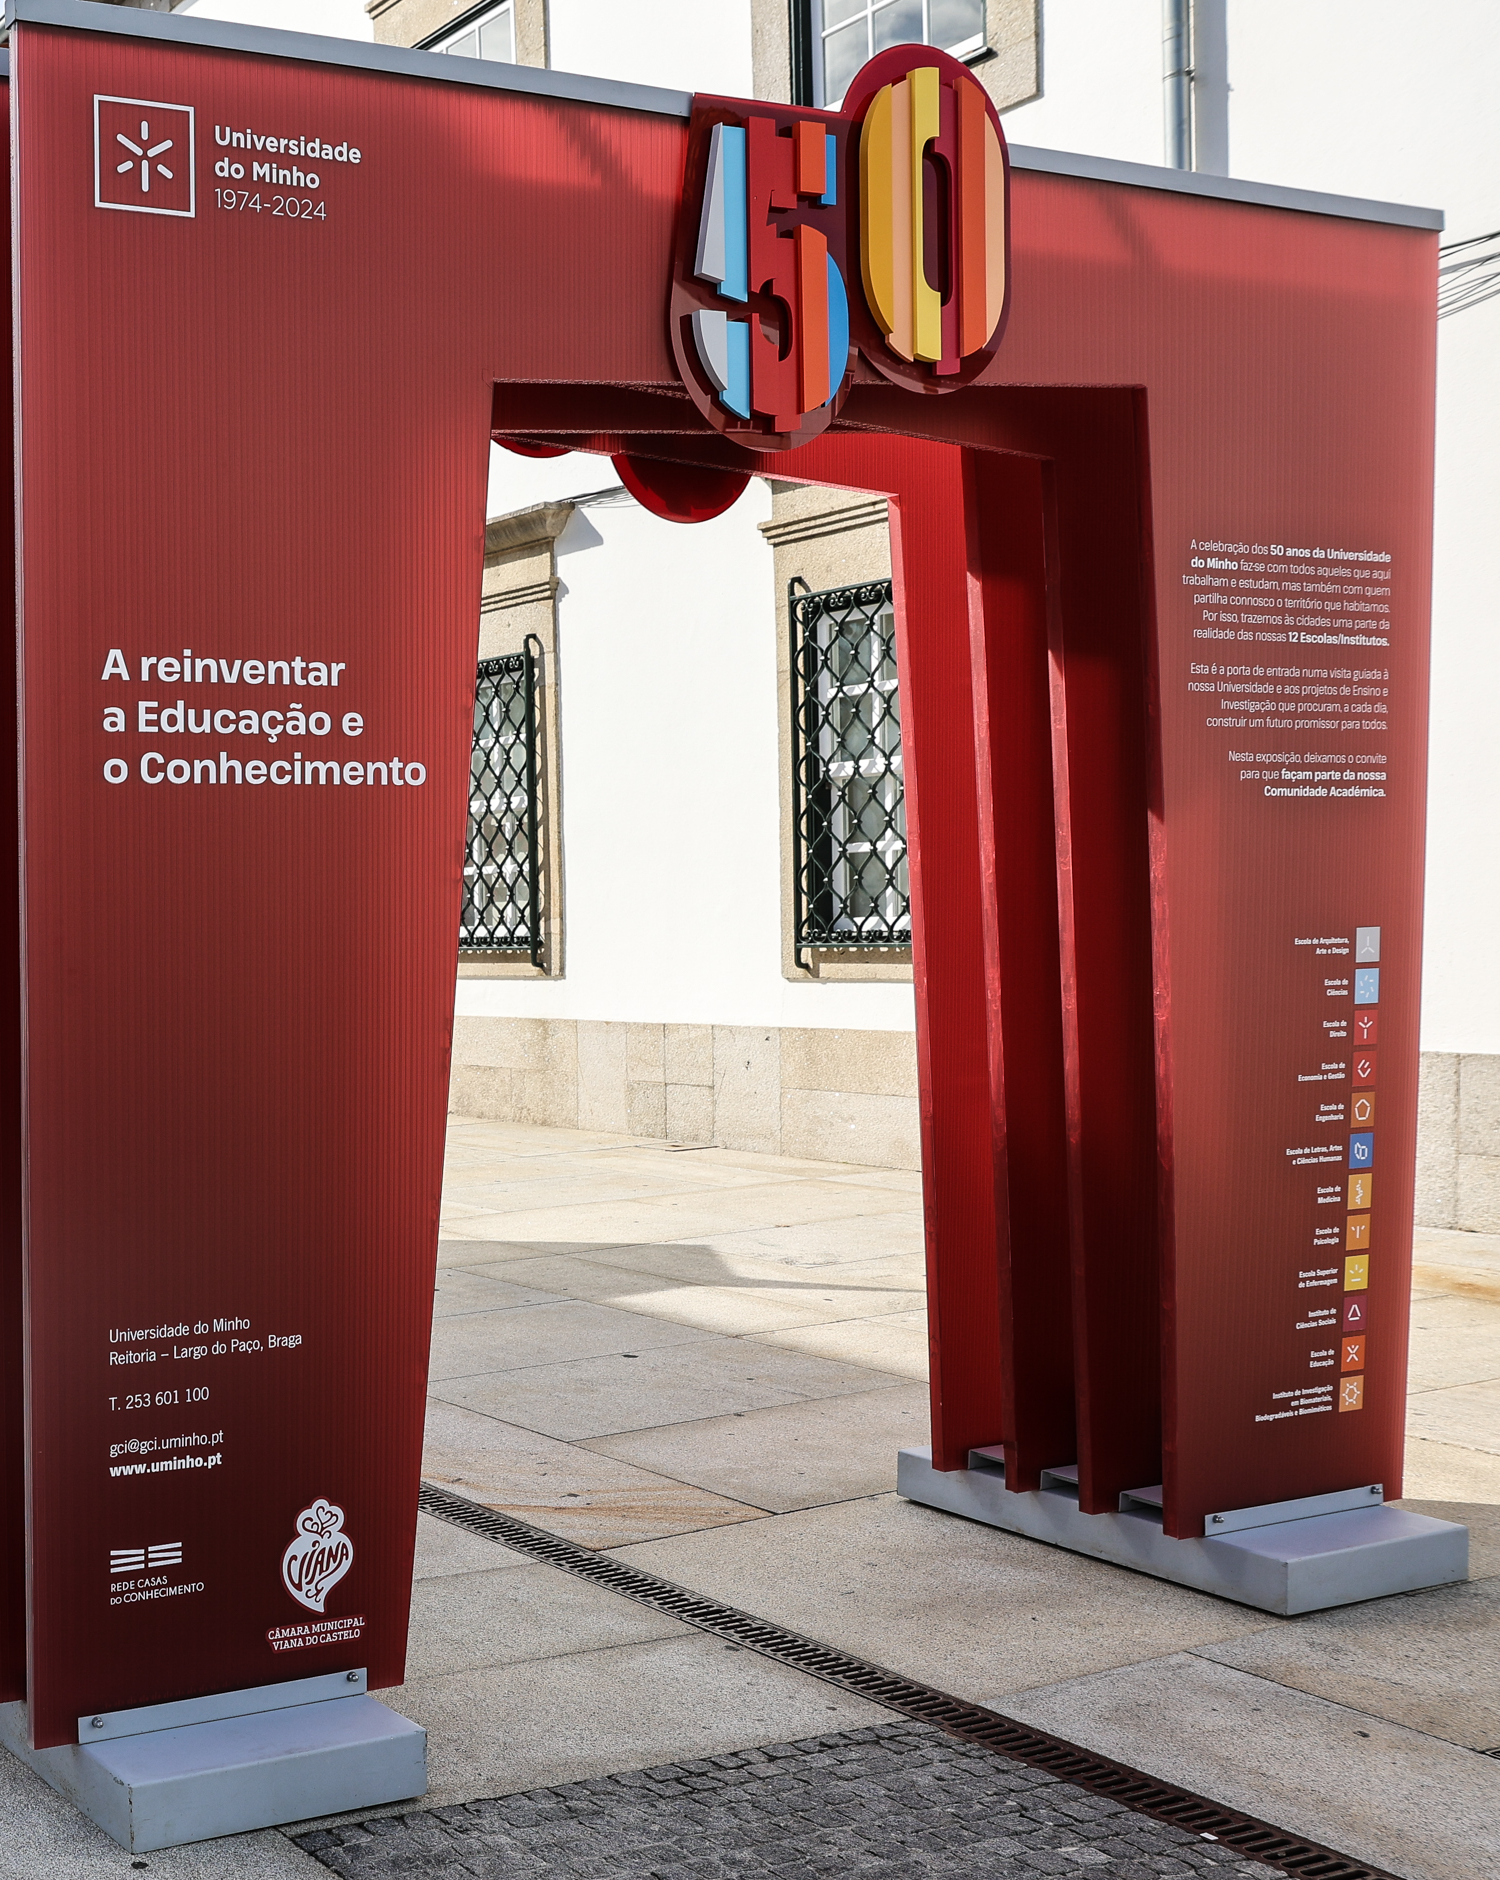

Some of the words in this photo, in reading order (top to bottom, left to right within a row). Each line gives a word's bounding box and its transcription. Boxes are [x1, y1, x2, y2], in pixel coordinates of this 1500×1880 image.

[215, 125, 361, 163] Universidade
[215, 157, 244, 179] do
[253, 162, 319, 188] Minho
[215, 188, 326, 220] 1974-2024
[692, 67, 1006, 432] 50
[1191, 539, 1197, 549] A
[1199, 540, 1249, 555] celebração
[1252, 543, 1268, 555] dos
[1270, 545, 1284, 555] 50
[1286, 548, 1311, 557] anos
[1313, 547, 1325, 558] da
[1327, 549, 1391, 562] Universidade
[1191, 556, 1205, 568] do
[1207, 558, 1238, 570] Minho
[1240, 559, 1265, 572] faz-se
[1267, 564, 1288, 573] com
[1290, 563, 1315, 575] todos
[1317, 566, 1351, 578] aqueles
[1354, 569, 1370, 579] que
[1372, 569, 1391, 581] aqui
[1182, 574, 1228, 587] trabalham
[1231, 579, 1236, 587] e
[1239, 578, 1280, 590] estudam,
[1282, 582, 1301, 591] mas
[1303, 582, 1341, 593] também
[1343, 585, 1363, 594] com
[1365, 587, 1390, 597] quem
[1194, 593, 1227, 605] partilha
[1230, 596, 1274, 607] connosco
[1277, 599, 1282, 607] o
[1285, 598, 1322, 609] território
[1324, 601, 1341, 612] que
[1344, 600, 1390, 613] habitamos.
[1203, 610, 1218, 621] Por
[1220, 611, 1239, 623] isso,
[1241, 613, 1282, 624] trazemos
[1284, 614, 1294, 625] às
[1296, 615, 1331, 627] cidades
[1333, 619, 1352, 628] uma
[1355, 620, 1377, 630] parte
[1379, 619, 1390, 629] da
[1194, 627, 1235, 639] realidade
[1237, 629, 1253, 640] das
[1256, 632, 1286, 642] nossas
[1288, 632, 1298, 642] 12
[1300, 632, 1390, 646] Escolas/Institutos.
[101, 649, 130, 680] A
[141, 649, 345, 686] reinventar
[1191, 663, 1209, 674] Esta
[1211, 663, 1217, 674] é
[1219, 666, 1224, 674] a
[1227, 665, 1250, 677] porta
[1253, 665, 1264, 676] de
[1267, 666, 1300, 677] entrada
[1302, 669, 1327, 678] numa
[1330, 668, 1351, 678] visita
[1353, 669, 1381, 681] guiada
[1188, 682, 1215, 691] nossa
[1217, 681, 1274, 693] Universidade
[1276, 685, 1282, 693] e
[1284, 685, 1300, 694] aos
[1302, 684, 1337, 697] projetos
[1340, 685, 1351, 695] de
[1353, 685, 1381, 696] Ensino
[1383, 688, 1388, 696] e
[1221, 699, 1276, 712] Investigação
[1278, 702, 1295, 713] que
[1298, 703, 1342, 713] procuram,
[1344, 704, 1349, 712] a
[1351, 702, 1372, 713] cada
[1374, 702, 1388, 713] dia,
[103, 707, 125, 732] a
[138, 700, 331, 743] Educação
[342, 712, 363, 736] e
[1207, 716, 1247, 727] construir
[1249, 719, 1264, 727] um
[1266, 716, 1293, 728] futuro
[1295, 718, 1339, 730] promissor
[1341, 721, 1360, 731] para
[1362, 719, 1388, 730] todos.
[104, 759, 128, 784] o
[141, 752, 426, 786] Conhecimento
[1229, 751, 1253, 762] Nesta
[1256, 752, 1302, 765] exposição,
[1304, 752, 1346, 763] deixamos
[1348, 755, 1354, 763] o
[1356, 753, 1387, 764] convite
[1240, 770, 1259, 781] para
[1262, 771, 1279, 781] que
[1281, 768, 1312, 782] façam
[1315, 770, 1341, 782] parte
[1343, 769, 1355, 780] da
[1357, 772, 1386, 780] nossa
[1264, 786, 1327, 796] Comunidade
[1329, 786, 1386, 797] Académica.
[1332, 947, 1349, 955] Design
[110, 1323, 189, 1343] Universidade
[194, 1321, 208, 1334] do
[214, 1317, 250, 1332] Minho
[110, 1349, 156, 1365] Reitoria
[174, 1344, 207, 1359] Largo
[212, 1341, 226, 1354] do
[231, 1339, 263, 1353] Paço,
[269, 1335, 301, 1348] Braga
[109, 1397, 120, 1411] T.
[126, 1393, 150, 1409] 253
[156, 1390, 179, 1405] 601
[186, 1387, 209, 1402] 100
[110, 1430, 223, 1457] gci@gci.uminho.pt
[109, 1453, 222, 1477] www.uminho.pt
[110, 1597, 122, 1605] DO
[123, 1582, 204, 1602] CONHECIMENTO
[111, 1580, 135, 1592] REDE
[137, 1576, 167, 1588] CASAS
[268, 1626, 310, 1640] CÂMARA
[312, 1617, 365, 1633] MUNICIPAL
[273, 1638, 304, 1650] VIANA
[306, 1635, 318, 1645] DO
[320, 1629, 360, 1643] CASTELO
